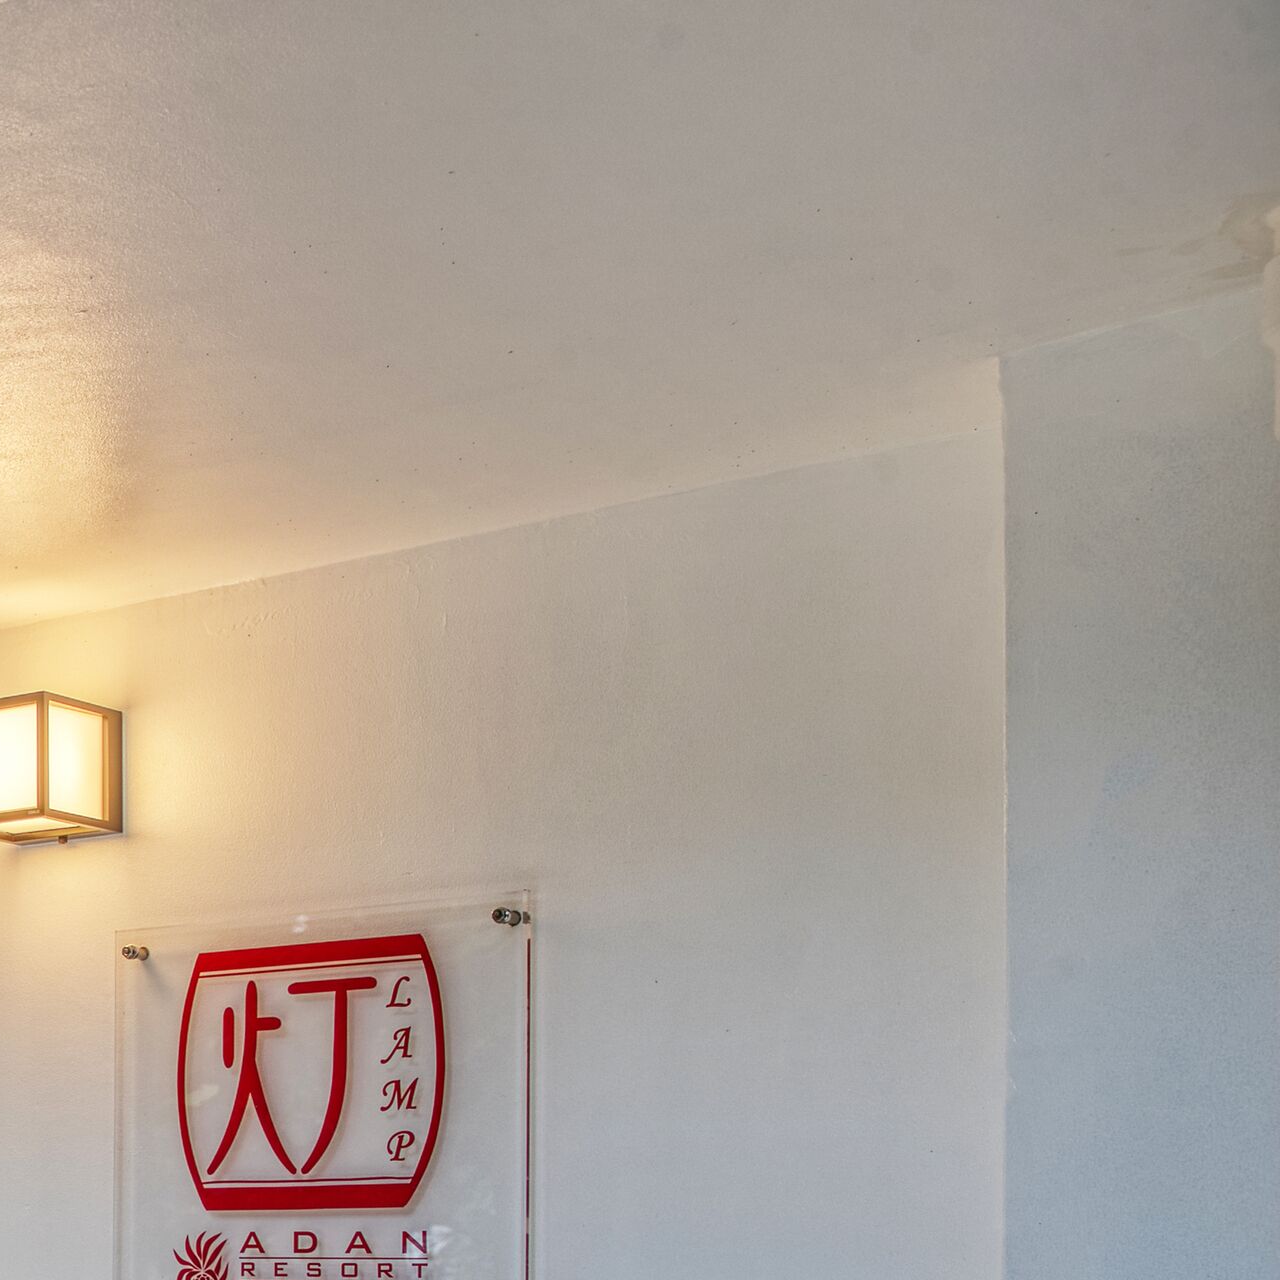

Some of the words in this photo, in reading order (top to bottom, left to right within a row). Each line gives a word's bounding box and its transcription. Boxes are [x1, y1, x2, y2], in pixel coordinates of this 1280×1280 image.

[207, 976, 378, 1175] 灯
[380, 976, 419, 1162] LAMP
[239, 1231, 428, 1254] ADAN
[241, 1262, 428, 1278] RESORT
